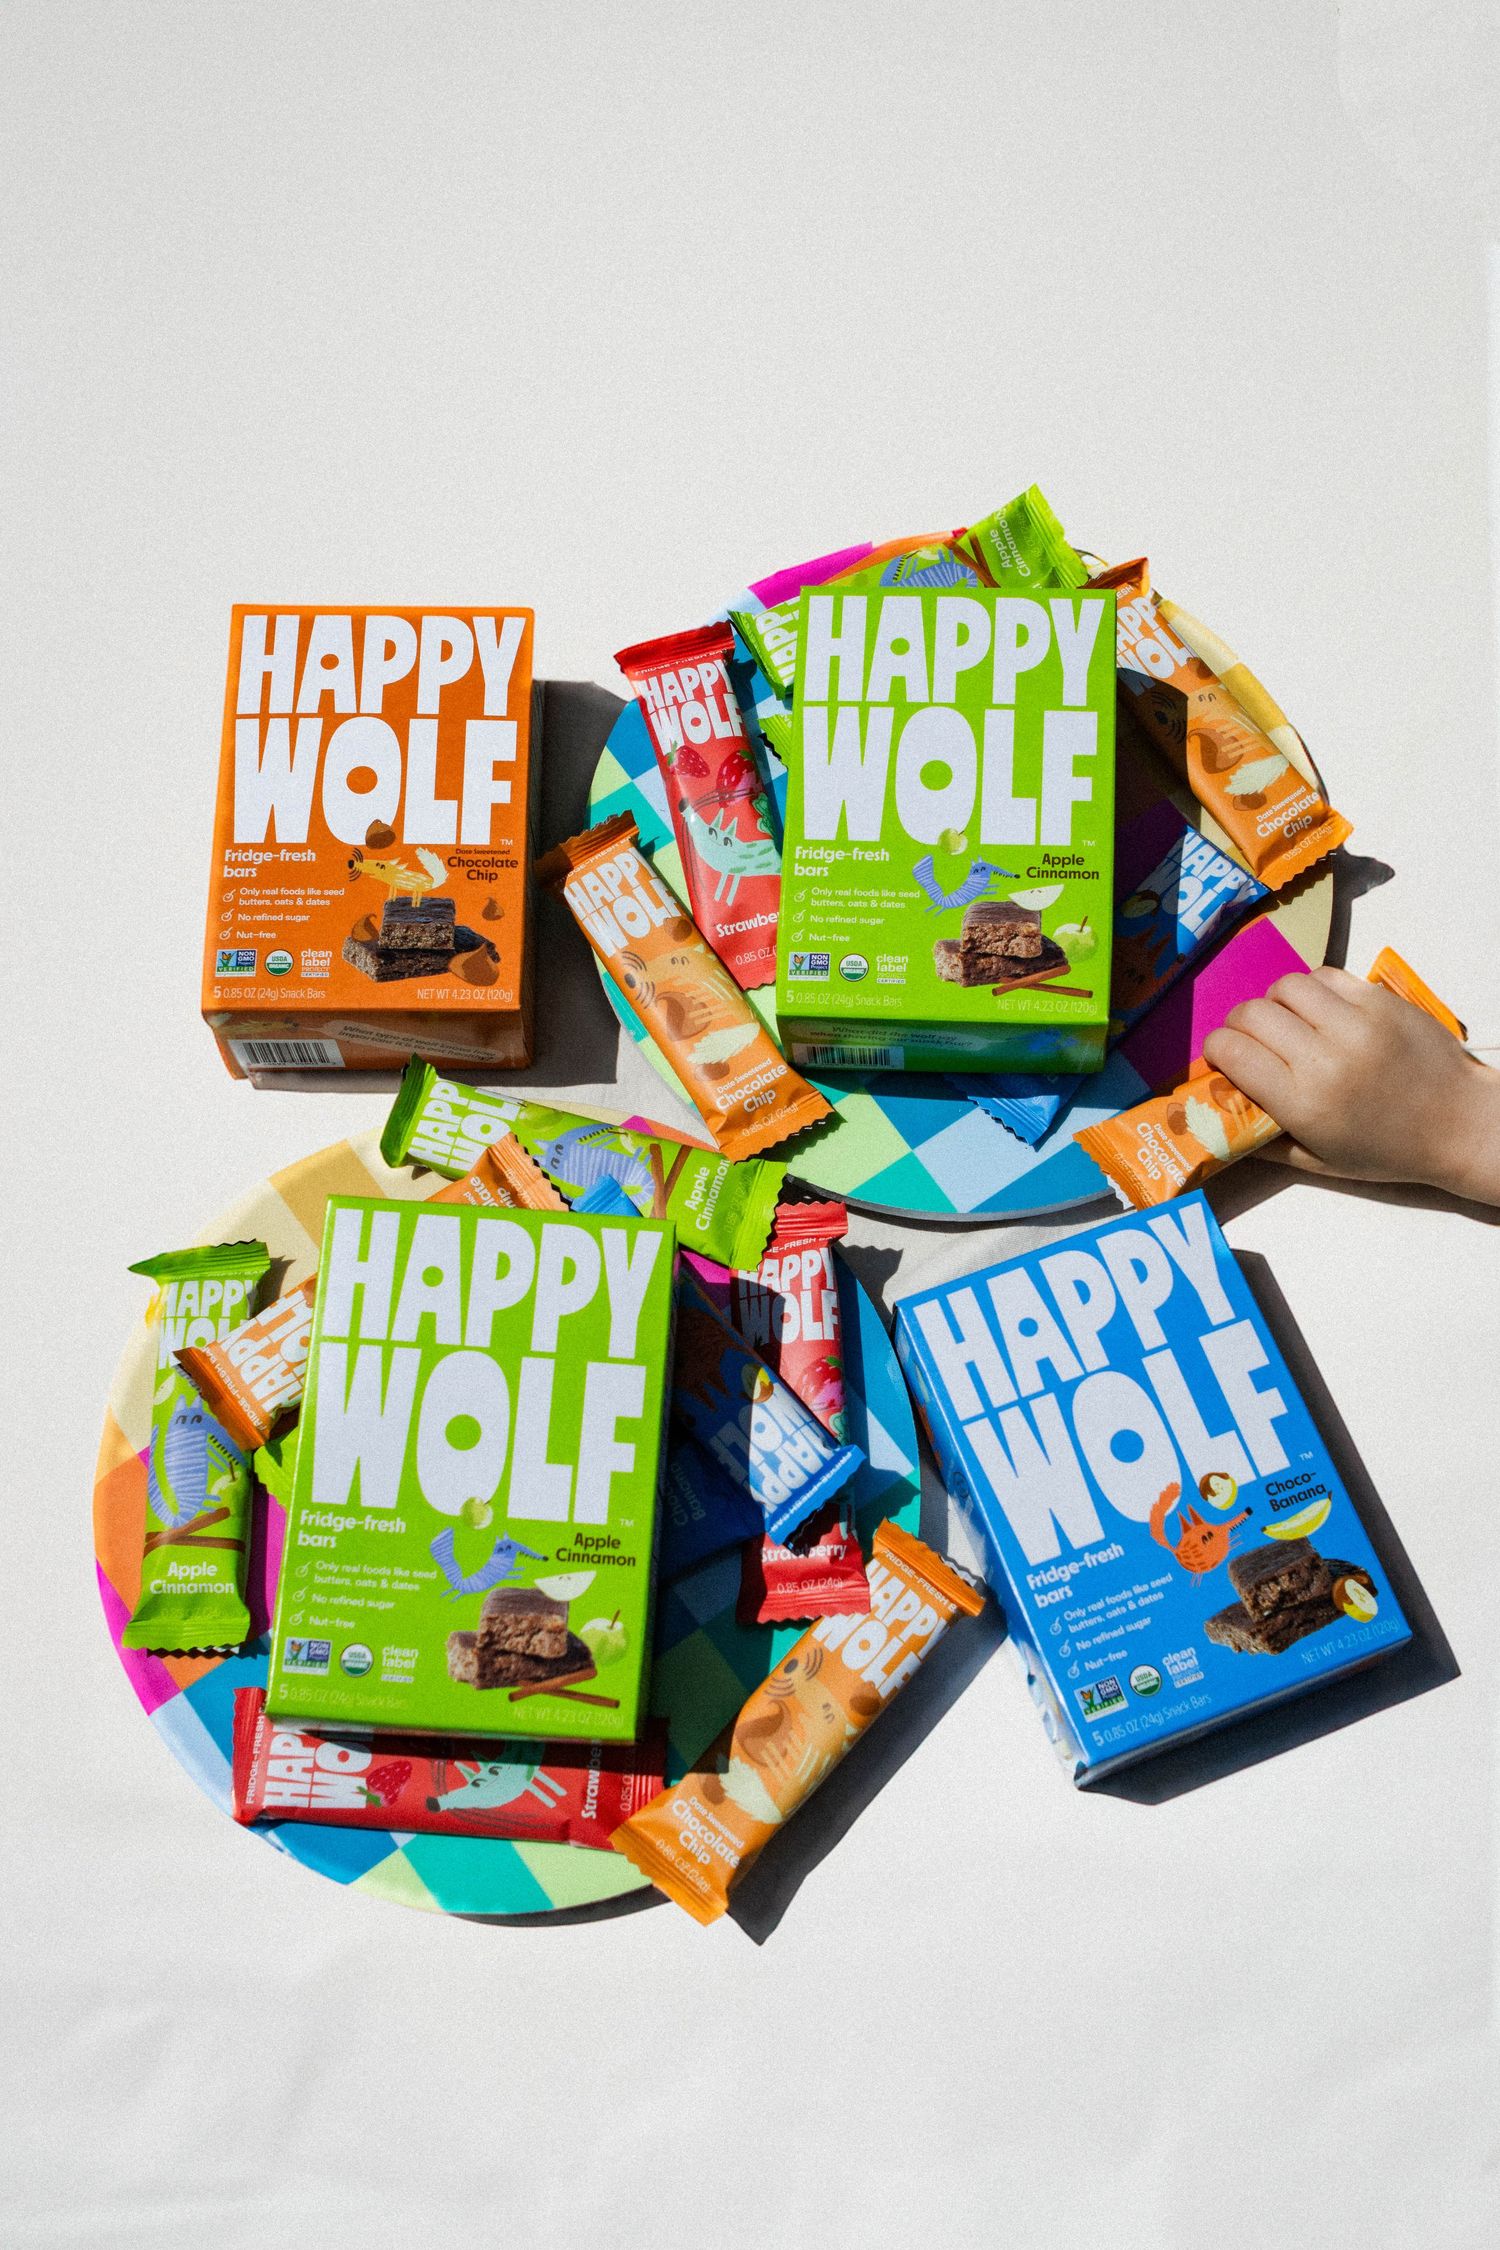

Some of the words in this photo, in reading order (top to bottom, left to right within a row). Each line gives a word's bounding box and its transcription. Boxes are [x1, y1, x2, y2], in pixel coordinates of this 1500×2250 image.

[990, 529, 1012, 569] Apple
[803, 595, 1106, 707] HAPPY
[236, 614, 527, 717] HAPPY
[233, 716, 518, 846] WOLF
[802, 706, 1098, 846] WOLF
[1256, 791, 1321, 839] Chocolate
[1283, 814, 1313, 839] Chip
[224, 849, 316, 864] Fridge-fresh
[447, 856, 519, 869] Chocolate
[795, 846, 890, 863] Fridge-fresh
[1042, 853, 1085, 867] Apple
[223, 865, 257, 878] bars
[466, 869, 499, 884] Chip
[794, 863, 829, 877] bars
[1026, 866, 1100, 880] Cinnamon
[240, 887, 260, 897] Only
[262, 887, 279, 896] real
[280, 887, 305, 896] foods
[307, 887, 322, 896] like
[323, 887, 345, 896] seed
[296, 898, 303, 906] &
[305, 898, 331, 906] dates
[811, 887, 833, 897] Only
[835, 888, 852, 897] real
[853, 888, 879, 897] foods
[881, 889, 896, 898] like
[898, 890, 921, 899] seed
[848, 900, 868, 908] oats
[870, 899, 878, 908] &
[880, 901, 906, 909] dates
[237, 913, 252, 921] No
[253, 913, 284, 921] refined
[285, 914, 311, 923] sugar
[582, 878, 682, 958] WOLF
[715, 912, 780, 938] Strawbe
[809, 915, 825, 923] No
[825, 915, 857, 924] refined
[859, 917, 885, 926] sugar
[301, 949, 333, 958] clean
[302, 957, 331, 967] label
[735, 950, 757, 966] 0.85
[876, 954, 909, 964] clean
[877, 963, 907, 972] label
[213, 986, 222, 999] 5
[223, 987, 243, 999] 0.85
[243, 988, 257, 999] OZ
[257, 988, 279, 1000] (24g)
[280, 987, 305, 999] Snack
[307, 989, 326, 999] Bars
[417, 988, 434, 1000] NET
[436, 988, 450, 1000] WT
[451, 988, 471, 1000] 4.23
[473, 989, 486, 1000] OZ
[487, 989, 514, 1002] (120g)
[786, 990, 795, 1003] 5
[715, 1064, 788, 1110] Chocolate
[743, 1089, 776, 1113] Chip
[408, 1078, 470, 1166] HAPP
[1136, 1122, 1187, 1188] Chocolate
[1136, 1147, 1162, 1181] Chip
[684, 1166, 710, 1211] Apple
[695, 1159, 731, 1231] Cinnamon
[321, 1207, 664, 1360] HAPPY
[739, 1290, 840, 1345] WOLF
[913, 1202, 1236, 1422] HAPPY
[311, 1341, 647, 1526] WOLF
[962, 1319, 1290, 1566] WOLF
[1265, 1471, 1317, 1497] Choco-
[1269, 1483, 1327, 1512] Banana
[300, 1509, 406, 1534] Fridge-fresh
[297, 1530, 337, 1548] bars
[574, 1532, 621, 1550] Apple
[556, 1548, 636, 1566] Cinnamon
[1026, 1542, 1125, 1591] Fridge-fresh
[167, 1561, 218, 1580] Apple
[150, 1580, 235, 1594] Cinnamon
[777, 1581, 800, 1594] 0.85
[801, 1579, 815, 1590] OZ
[1034, 1584, 1073, 1609] bars
[1063, 1607, 1087, 1622] Only
[1087, 1599, 1105, 1613] real
[1105, 1590, 1133, 1606] foods
[1132, 1584, 1150, 1595] like
[1151, 1572, 1174, 1589] seed
[1106, 1606, 1127, 1620] oats
[1138, 1591, 1165, 1608] dates
[1076, 1638, 1092, 1651] No
[1092, 1625, 1126, 1644] refined
[1126, 1616, 1152, 1633] sugar
[382, 1645, 419, 1659] clean
[1162, 1647, 1196, 1666] clean
[1166, 1656, 1199, 1676] label
[279, 1683, 288, 1700] 5
[1092, 1731, 1105, 1747] 5
[245, 1714, 265, 1805] FRIDGE-FRESH
[671, 1798, 740, 1868] Chocolate
[679, 1830, 711, 1864] Chip
